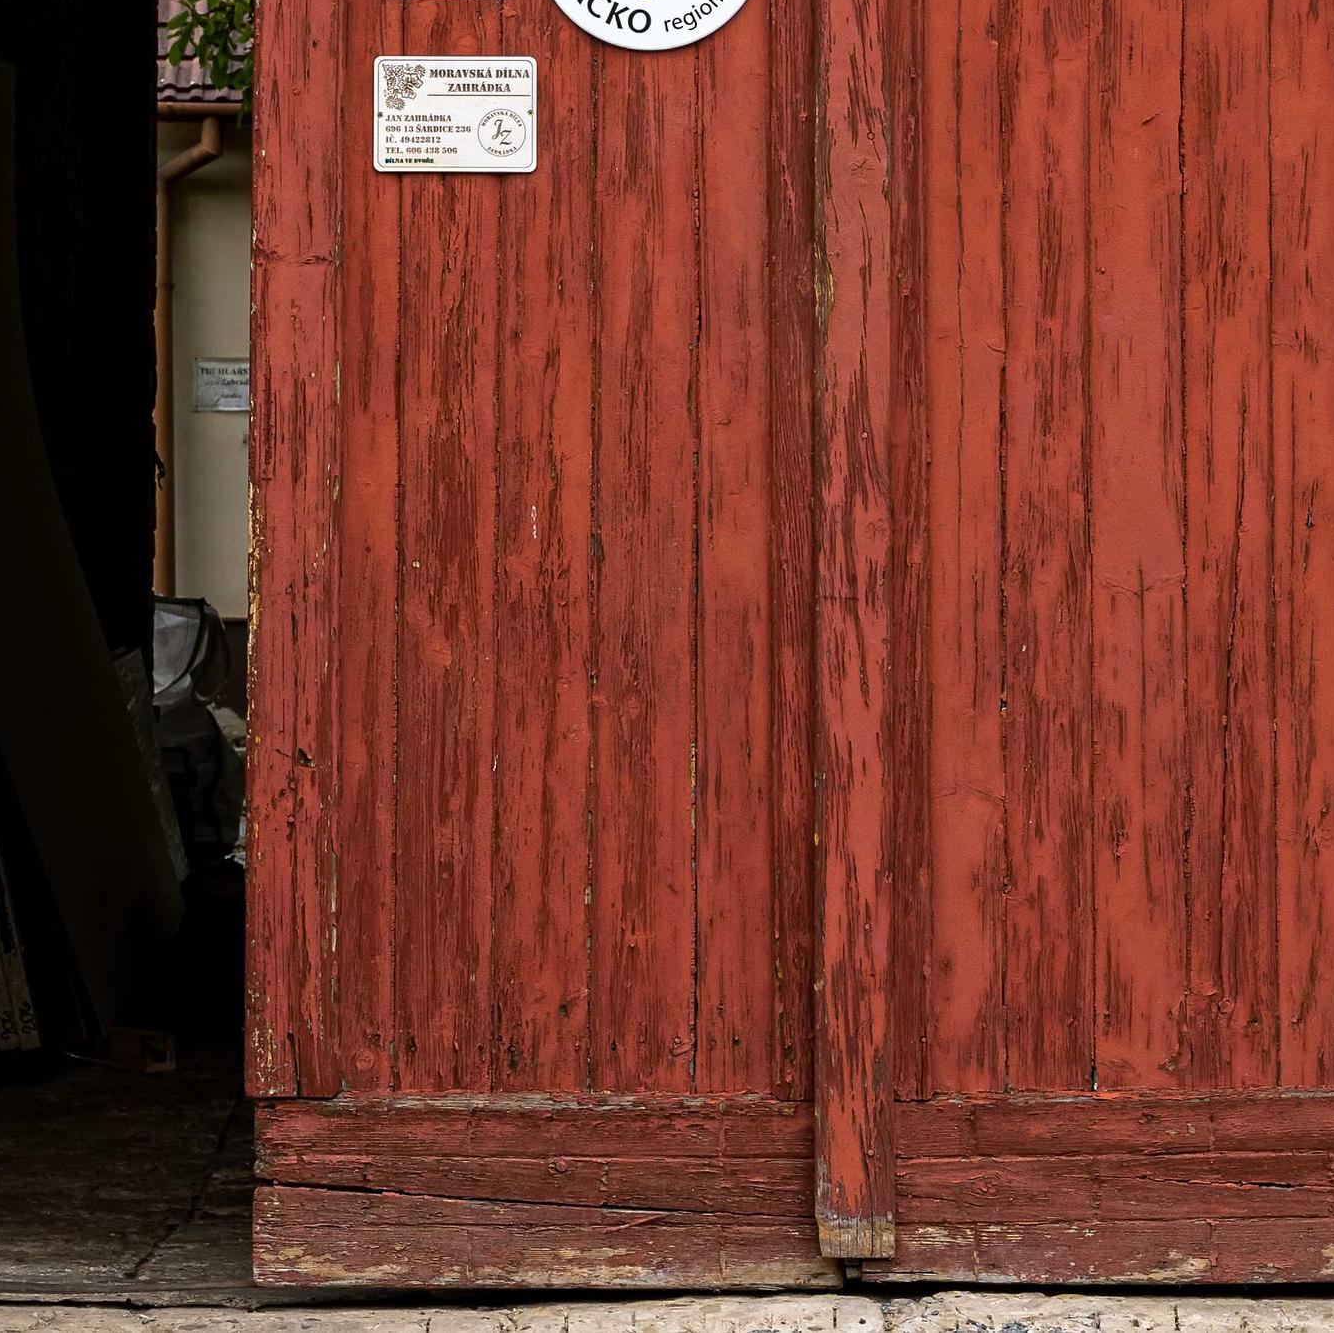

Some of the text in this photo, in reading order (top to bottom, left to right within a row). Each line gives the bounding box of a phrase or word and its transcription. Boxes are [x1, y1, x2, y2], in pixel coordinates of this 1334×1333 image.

[429, 67, 530, 78] MORAVSKÁ DÍLNA
[447, 81, 511, 92] ZAHRÁDKA
[385, 113, 452, 122] JAN ZAHRÁDKA
[385, 124, 471, 133] 696 13 ŠARDICE 236
